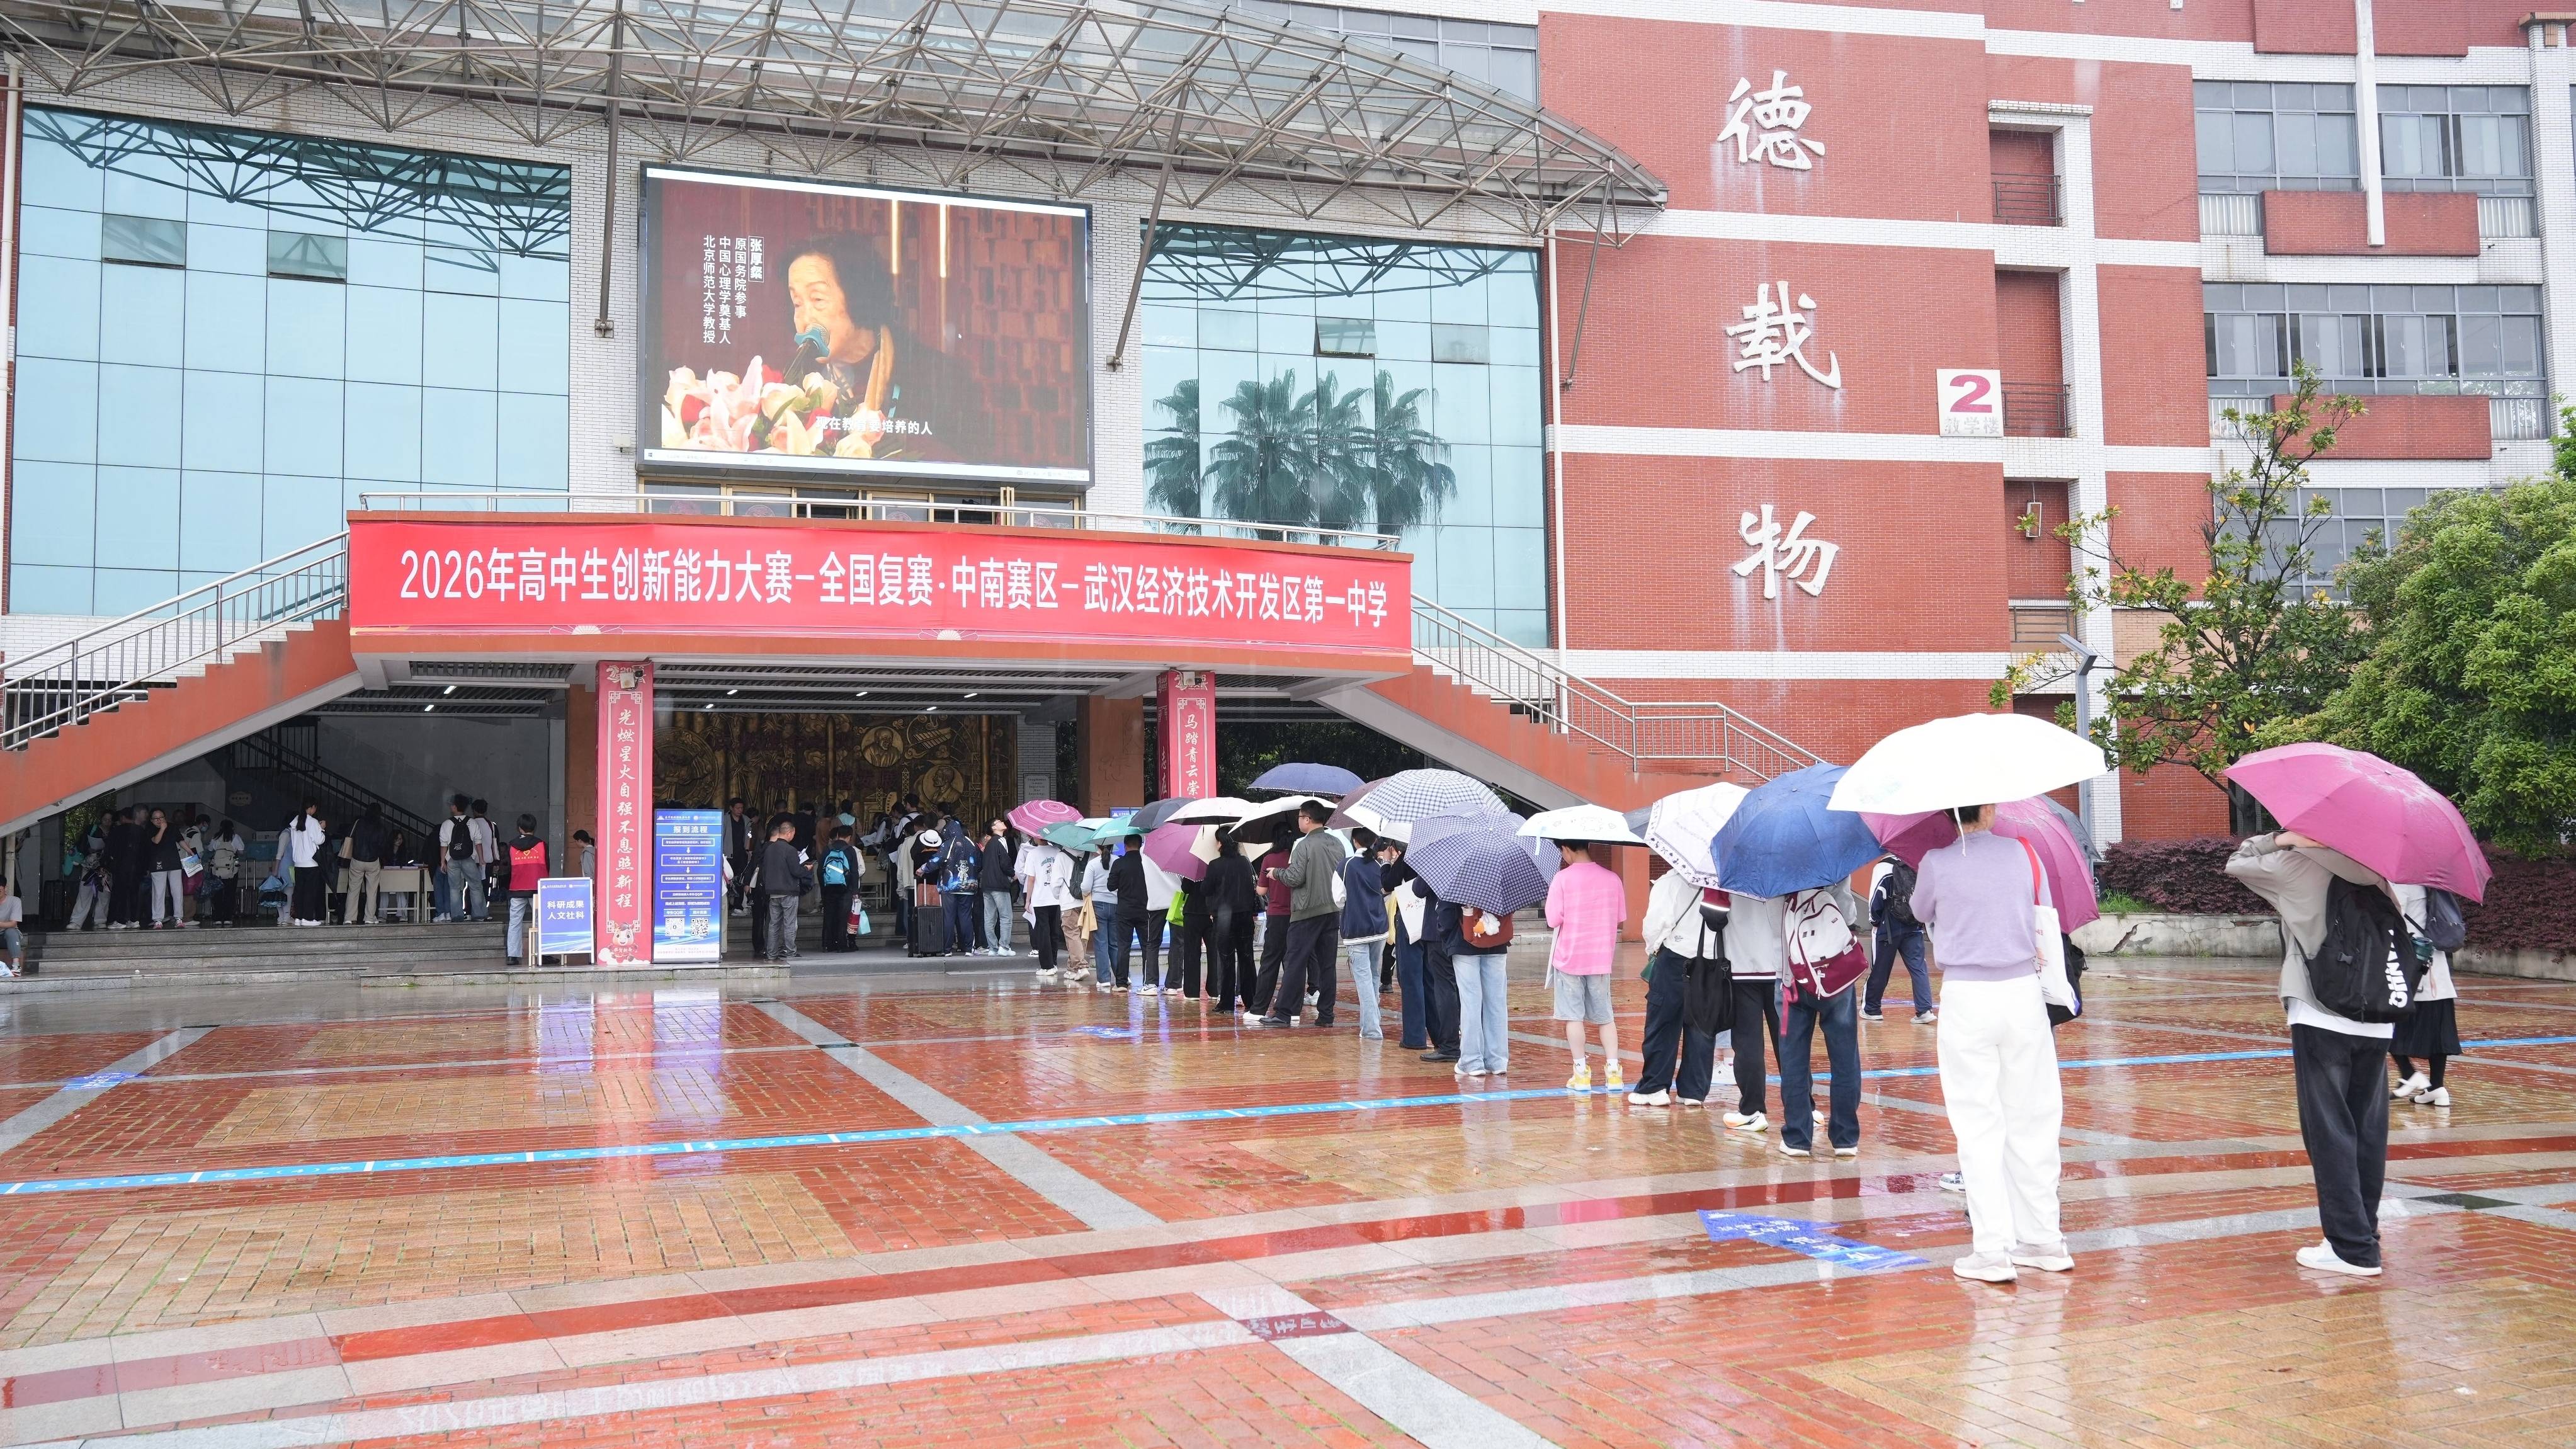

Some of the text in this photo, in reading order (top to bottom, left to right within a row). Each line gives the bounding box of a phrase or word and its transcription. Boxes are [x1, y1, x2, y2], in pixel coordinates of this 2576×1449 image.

[703, 234, 715, 344] 北京师范大学教授
[719, 236, 731, 344] 中国心理学奠基人
[735, 237, 747, 318] 原国务院参事
[1949, 374, 1992, 413] 2
[815, 415, 933, 435] 现在教育要培养的人
[1944, 416, 2000, 435] 教学楼
[1184, 713, 1200, 798] 马踏青云崇
[615, 708, 635, 909] 光燃星火自强不息照新程
[674, 826, 708, 834] 报到流程
[547, 900, 585, 909] 科研成果
[547, 911, 585, 920] 人文社科
